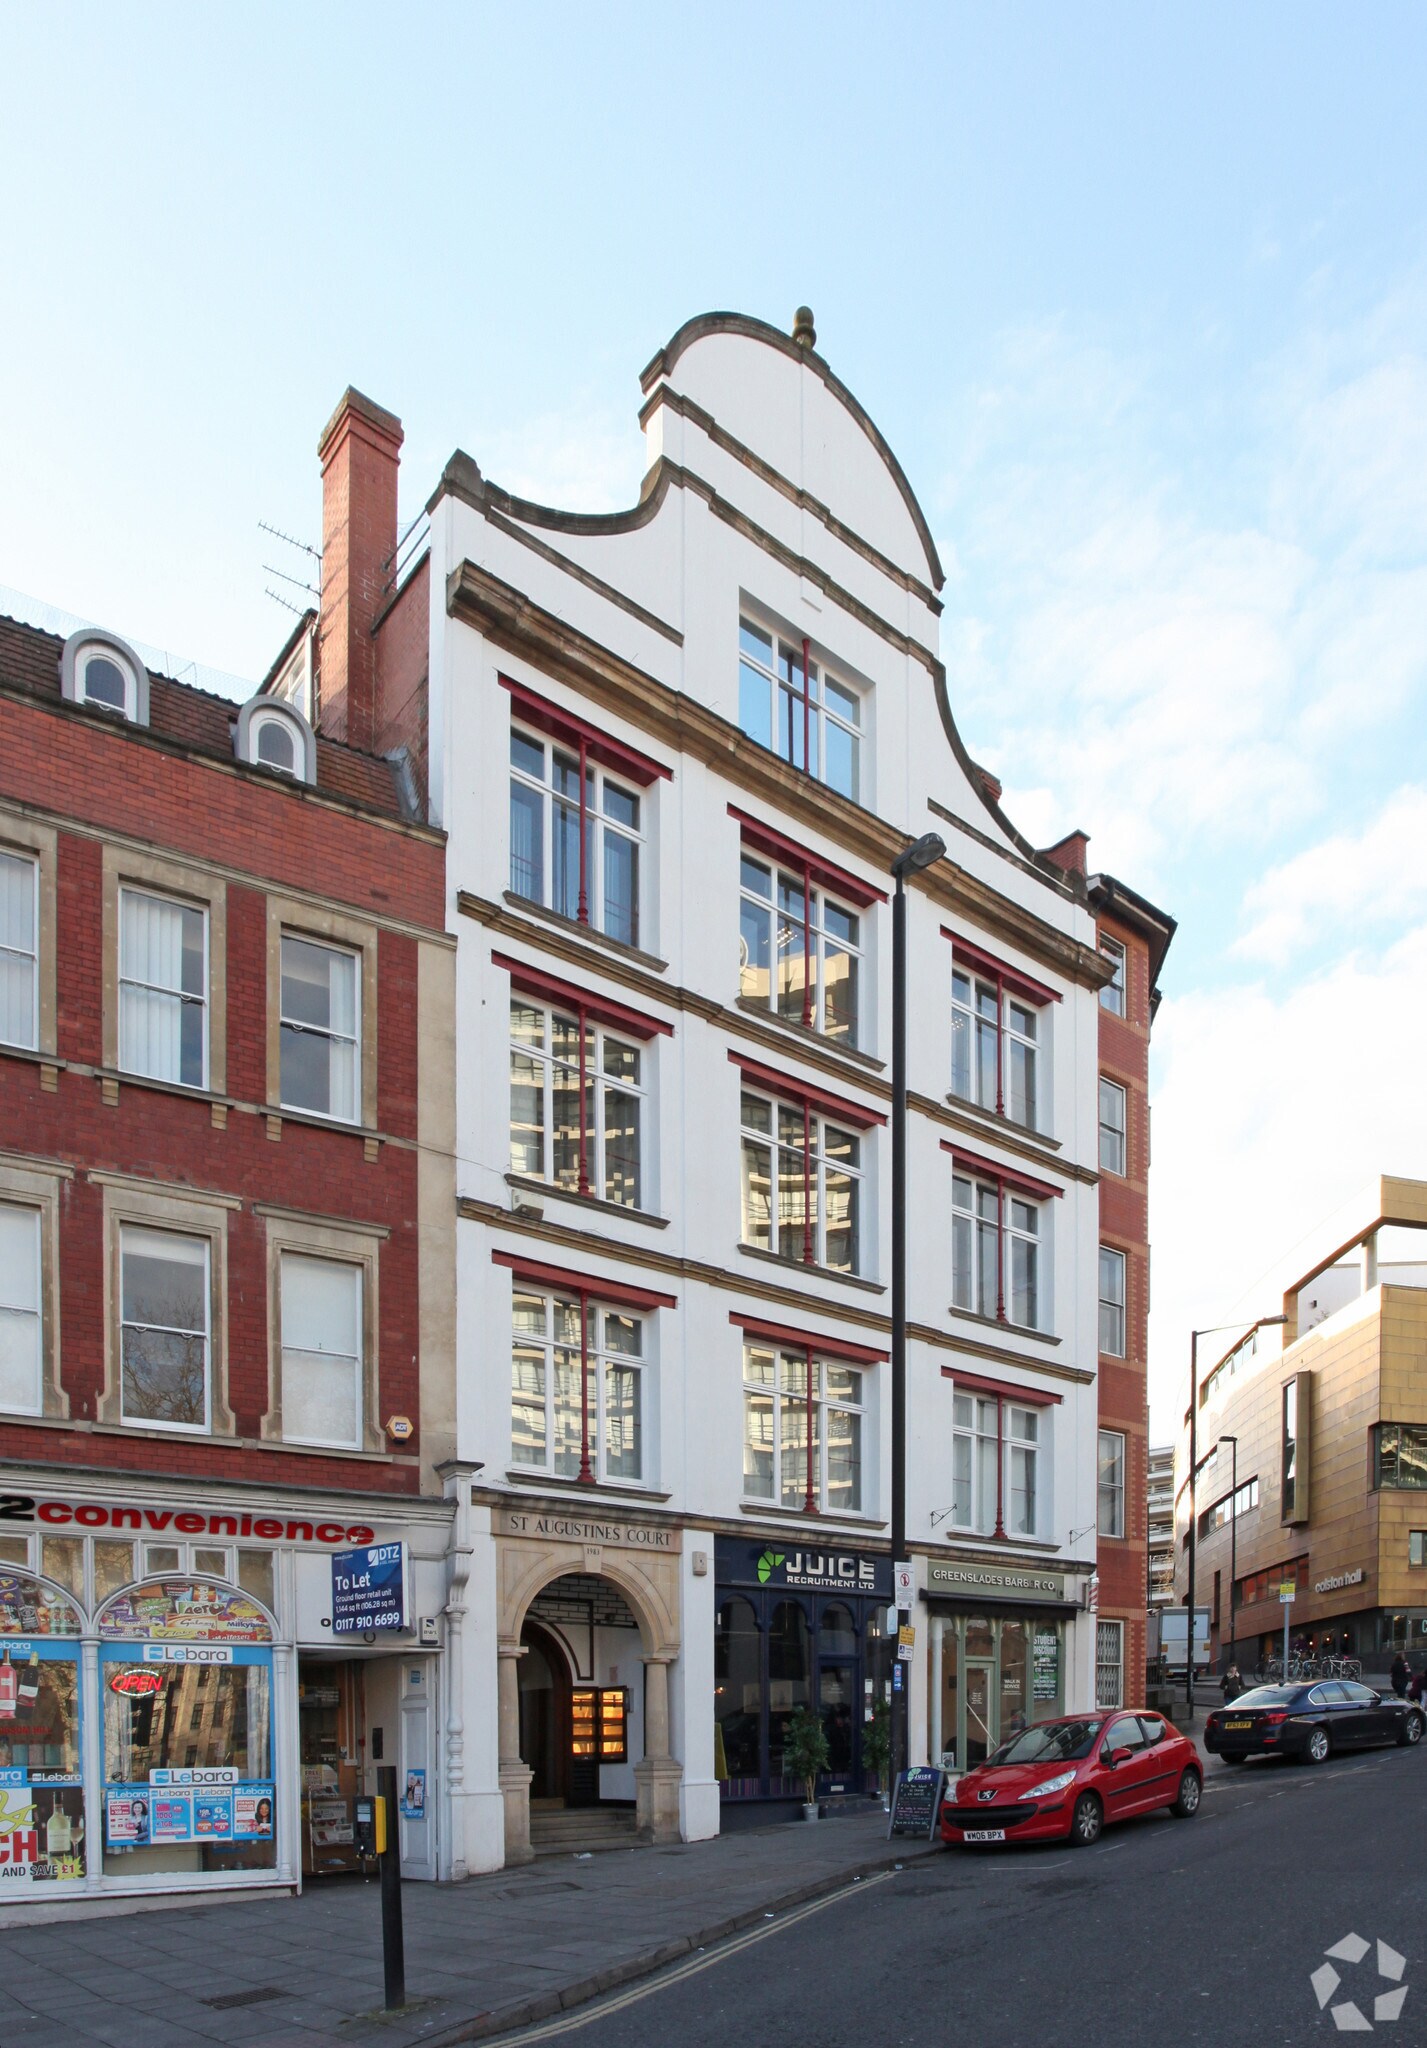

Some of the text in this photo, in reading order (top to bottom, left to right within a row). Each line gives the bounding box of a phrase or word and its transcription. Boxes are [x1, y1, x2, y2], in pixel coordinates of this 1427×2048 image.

[510, 1516, 671, 1546] ST AUGUSTINES COURT
[379, 1545, 400, 1560] DTZ
[786, 1553, 875, 1580] JUICE
[335, 1571, 370, 1590] To Let
[787, 1575, 875, 1590] RECRUITMENT LTD
[933, 1569, 1003, 1586] GREENSLADES
[1315, 1575, 1345, 1593] colston
[1344, 1568, 1362, 1586] hall
[335, 1588, 392, 1603] Ground floor retail unit
[356, 1602, 361, 1610] ft
[336, 1619, 355, 1631] 0117
[357, 1616, 372, 1627] 910
[375, 1612, 400, 1625] 6699
[1034, 1635, 1057, 1645] STUDENT
[165, 1646, 228, 1661] Lebara
[112, 1674, 163, 1692] OPEN
[42, 1772, 83, 1782] Lebara
[171, 1769, 233, 1783] Lebara
[115, 1790, 148, 1799] Lebara
[201, 1788, 231, 1796] Lebara
[242, 1787, 272, 1795] Lebara
[966, 1831, 1003, 1840] WM06 BPX
[2, 1864, 75, 1877] AND SAVE £1
